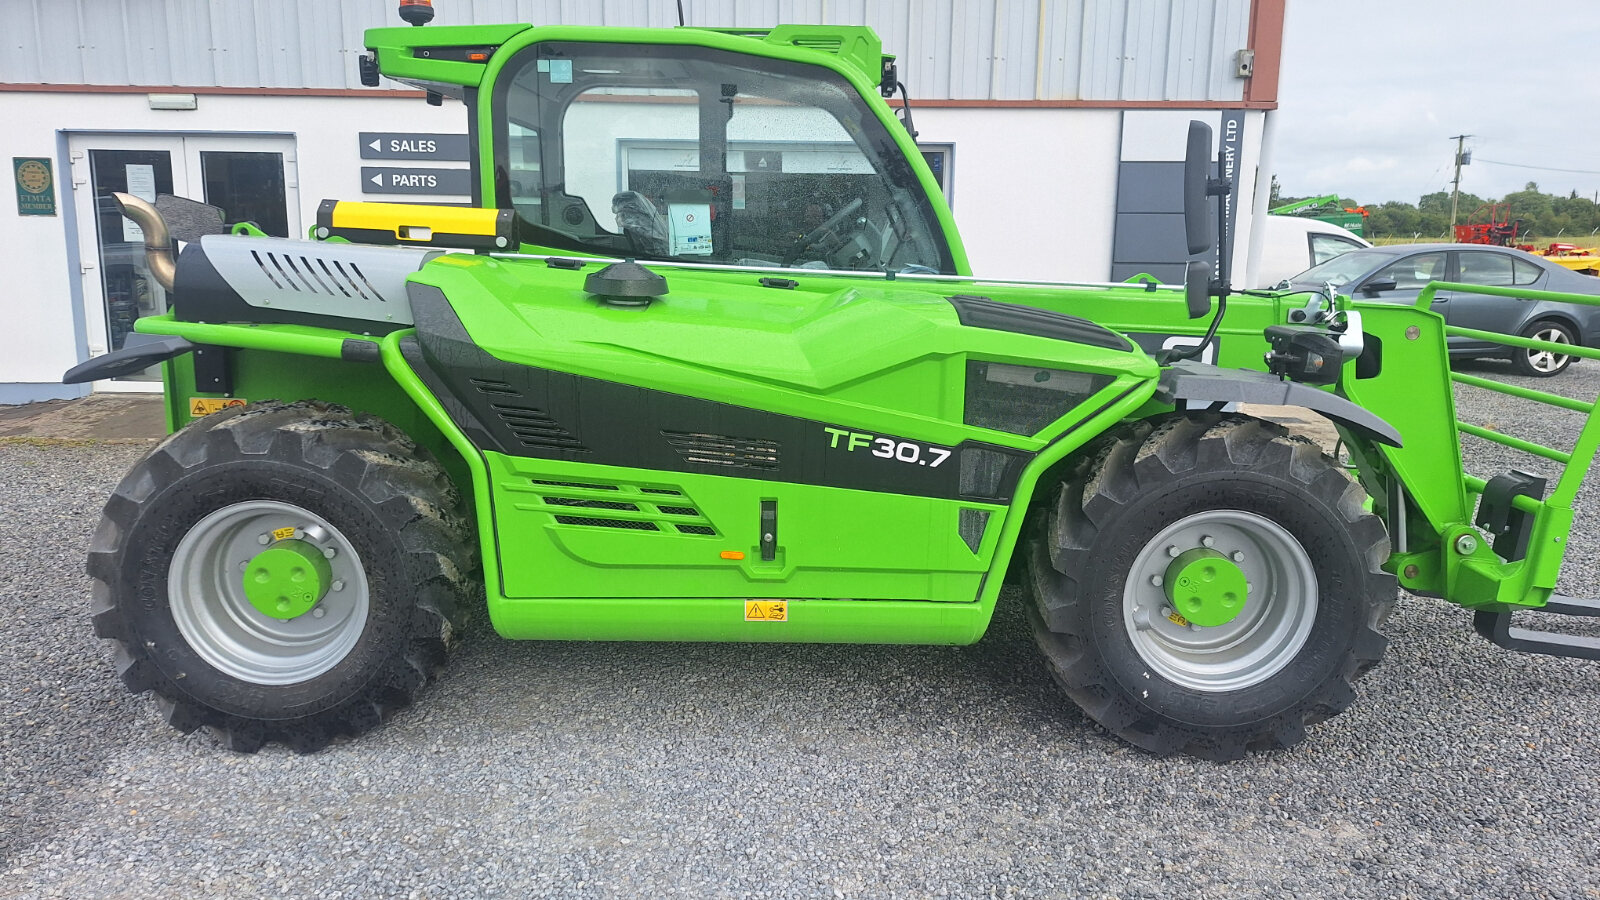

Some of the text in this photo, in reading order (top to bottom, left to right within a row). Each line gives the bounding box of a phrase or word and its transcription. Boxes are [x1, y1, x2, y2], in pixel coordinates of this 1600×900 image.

[1226, 120, 1237, 142] LTD
[390, 139, 437, 153] SALES
[392, 174, 437, 188] PARTS
[824, 427, 951, 468] TF30.7
